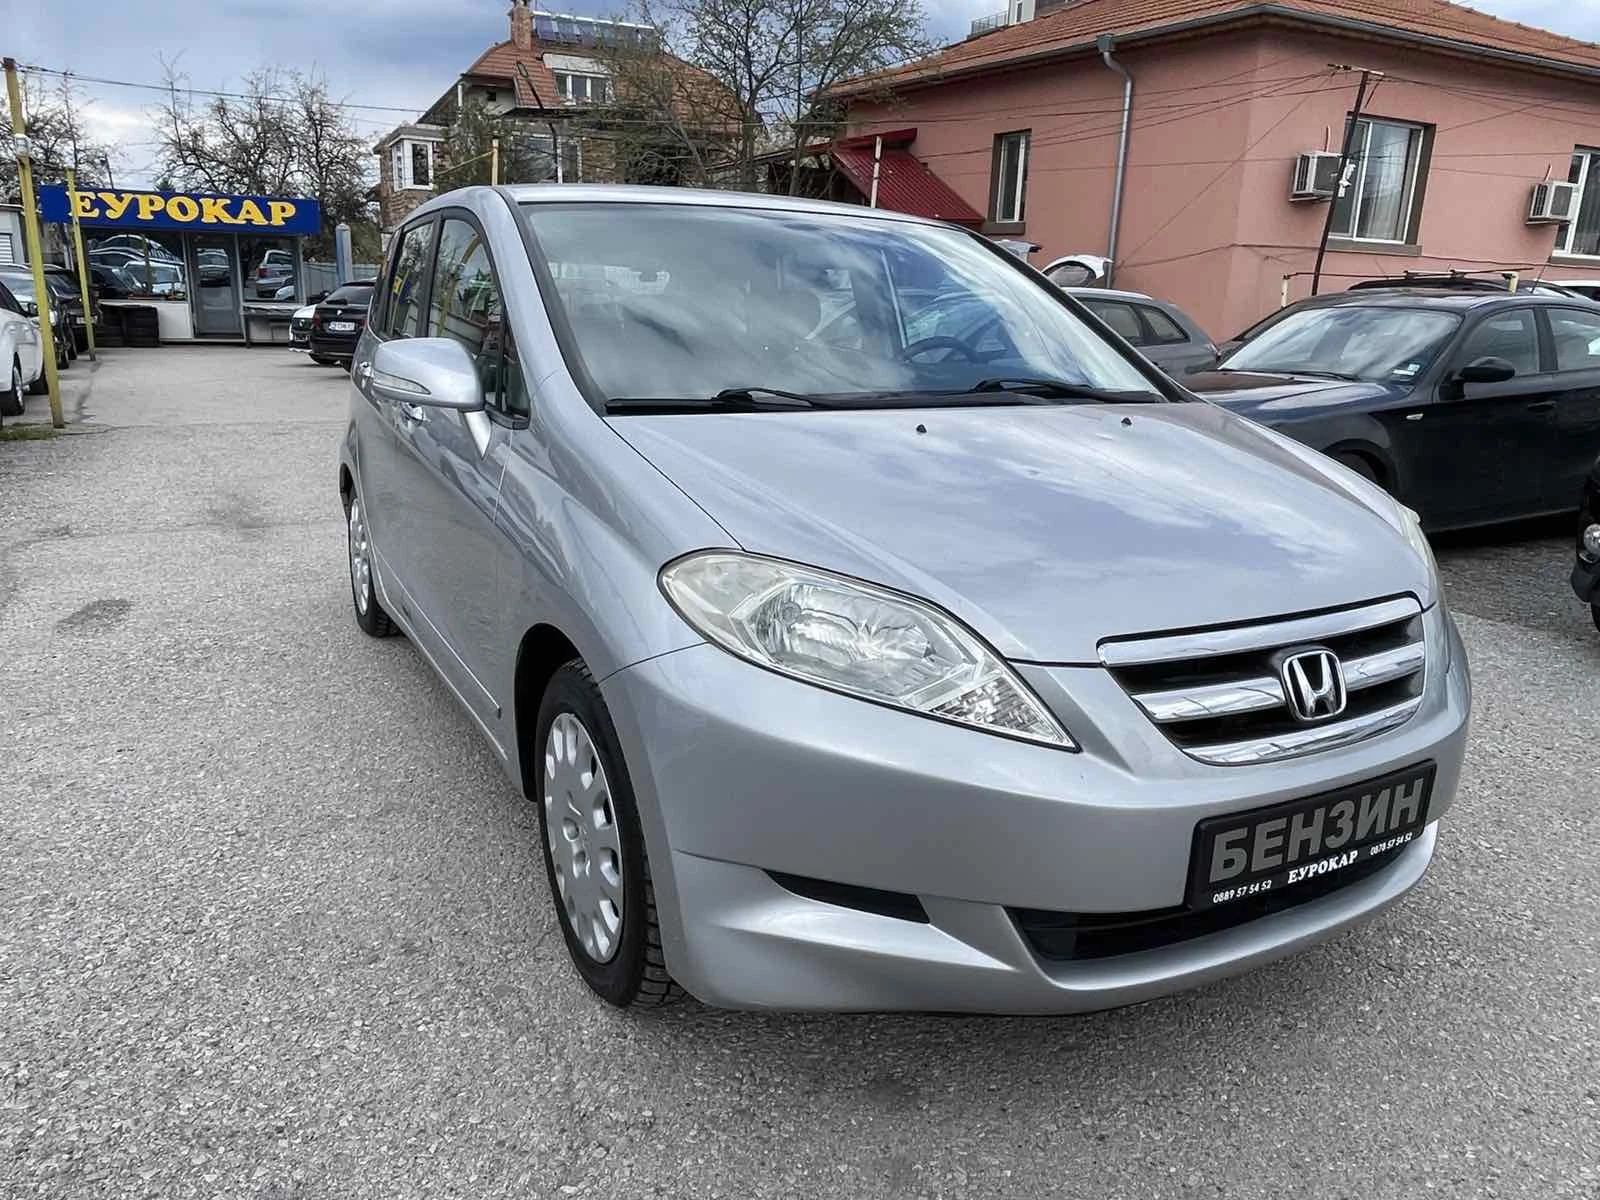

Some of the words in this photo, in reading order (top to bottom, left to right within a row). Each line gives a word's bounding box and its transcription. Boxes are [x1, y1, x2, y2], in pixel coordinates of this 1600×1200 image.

[65, 191, 296, 225] ЕУРОКАР
[1210, 779, 1424, 882] БЕНЗИН
[1212, 889, 1235, 904] 0889
[1236, 886, 1248, 898] 57
[1288, 850, 1358, 884] ЕУРОКАР
